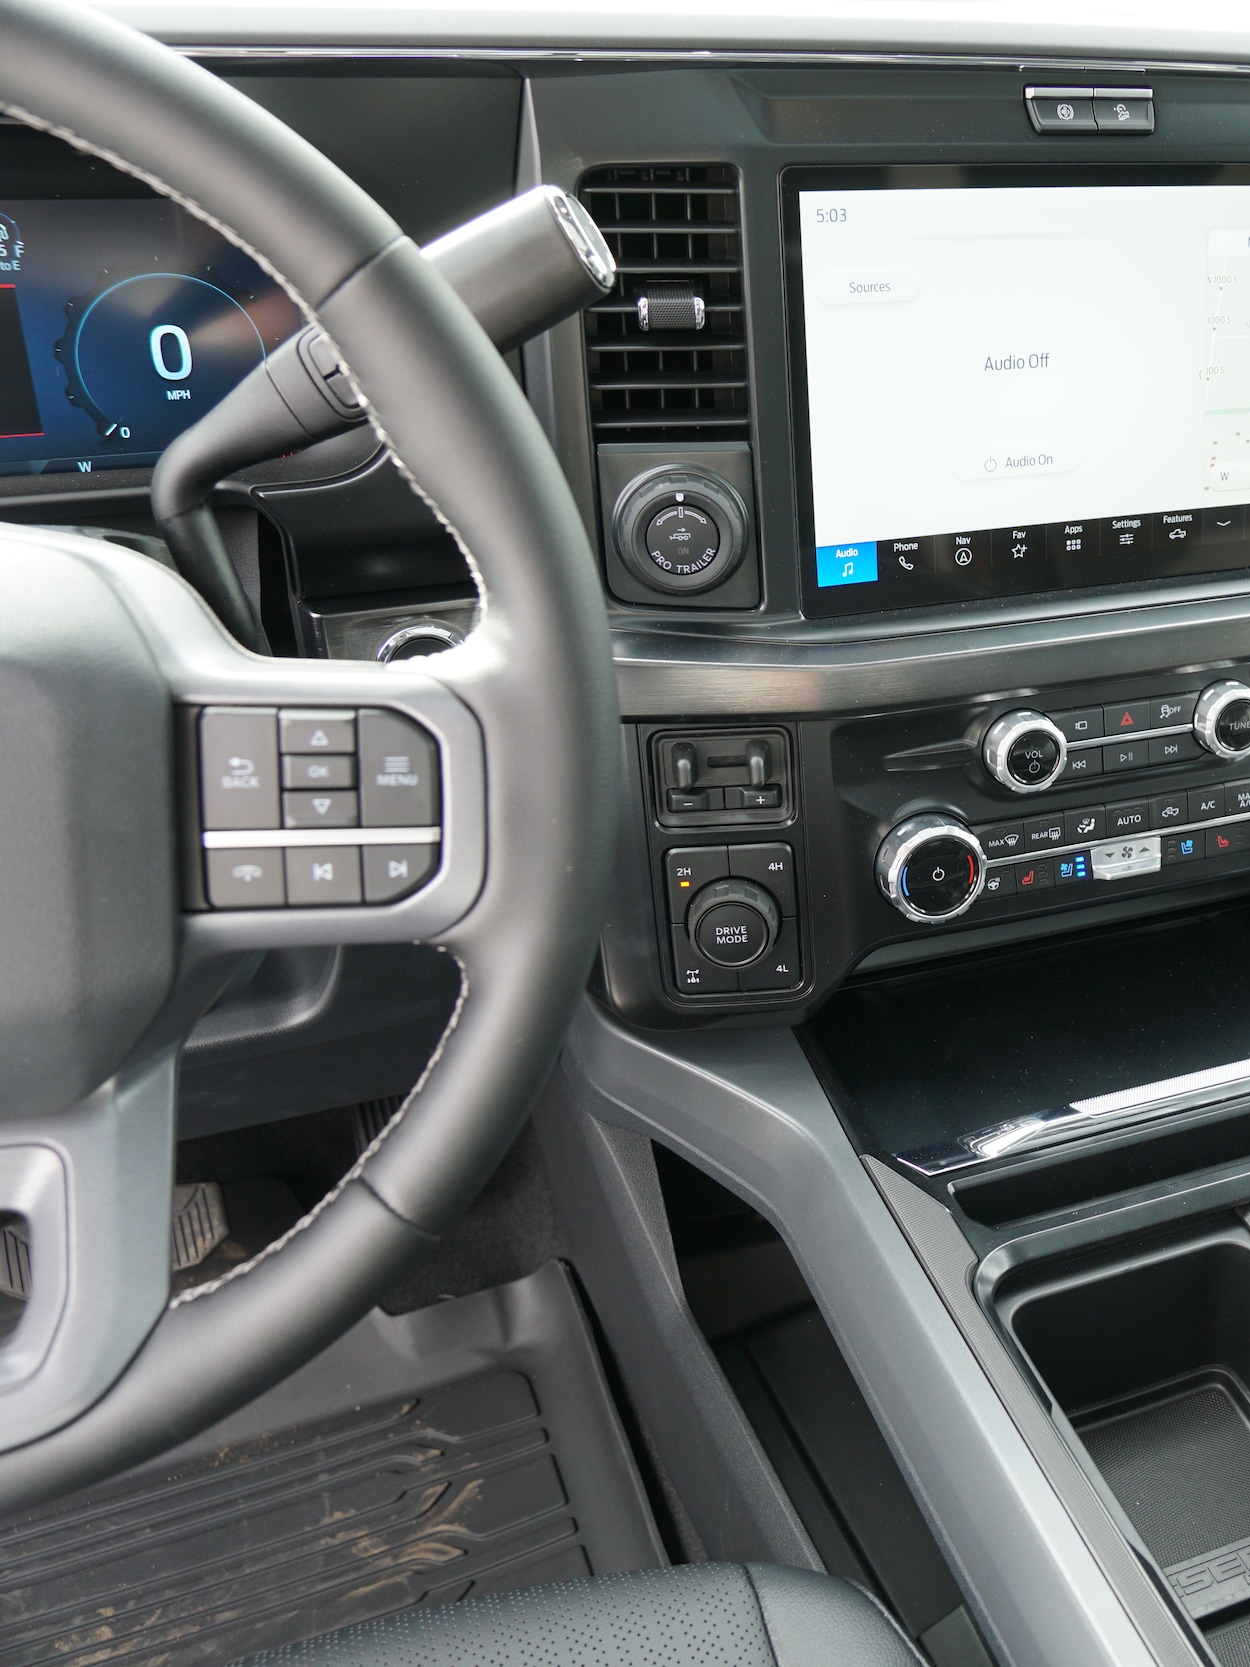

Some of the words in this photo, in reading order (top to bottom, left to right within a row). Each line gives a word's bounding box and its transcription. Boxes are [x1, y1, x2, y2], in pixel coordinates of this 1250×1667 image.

[816, 208, 847, 223] 5:03
[14, 245, 24, 258] F
[1214, 275, 1232, 284] 1000
[1233, 275, 1238, 284] S
[849, 281, 891, 294] Sources
[1227, 315, 1232, 324] S
[1245, 321, 1250, 329] S
[151, 324, 193, 381] 0
[984, 354, 1025, 371] Audio
[1028, 352, 1050, 369] Off
[166, 390, 191, 401] MPH
[120, 426, 131, 439] 0
[1005, 455, 1036, 468] Audio
[1038, 453, 1053, 466] On
[78, 461, 92, 473] W
[1220, 472, 1229, 481] W
[1112, 518, 1141, 530] Settings
[1163, 514, 1193, 524] Features
[1064, 524, 1083, 534] Apps
[1012, 530, 1026, 540] Fav
[956, 536, 971, 546] Nav
[894, 541, 918, 552] Phone
[835, 548, 859, 558] Audio
[651, 550, 672, 570] PRO
[676, 547, 716, 574] TRAILER
[1168, 706, 1181, 714] OFF
[1228, 720, 1250, 731] TUNE
[1025, 750, 1043, 760] VOL
[307, 766, 330, 778] OK
[221, 775, 260, 788] BACK
[376, 774, 418, 787] MENU
[1200, 800, 1216, 810] A/C
[1116, 814, 1142, 826] AUTO
[1031, 831, 1048, 841] REAR
[988, 838, 1005, 848] MAX
[676, 867, 692, 876] 2H
[768, 862, 784, 872] 4H
[715, 926, 748, 936] DRIVE
[716, 934, 749, 944] MODE
[776, 964, 789, 973] 4L
